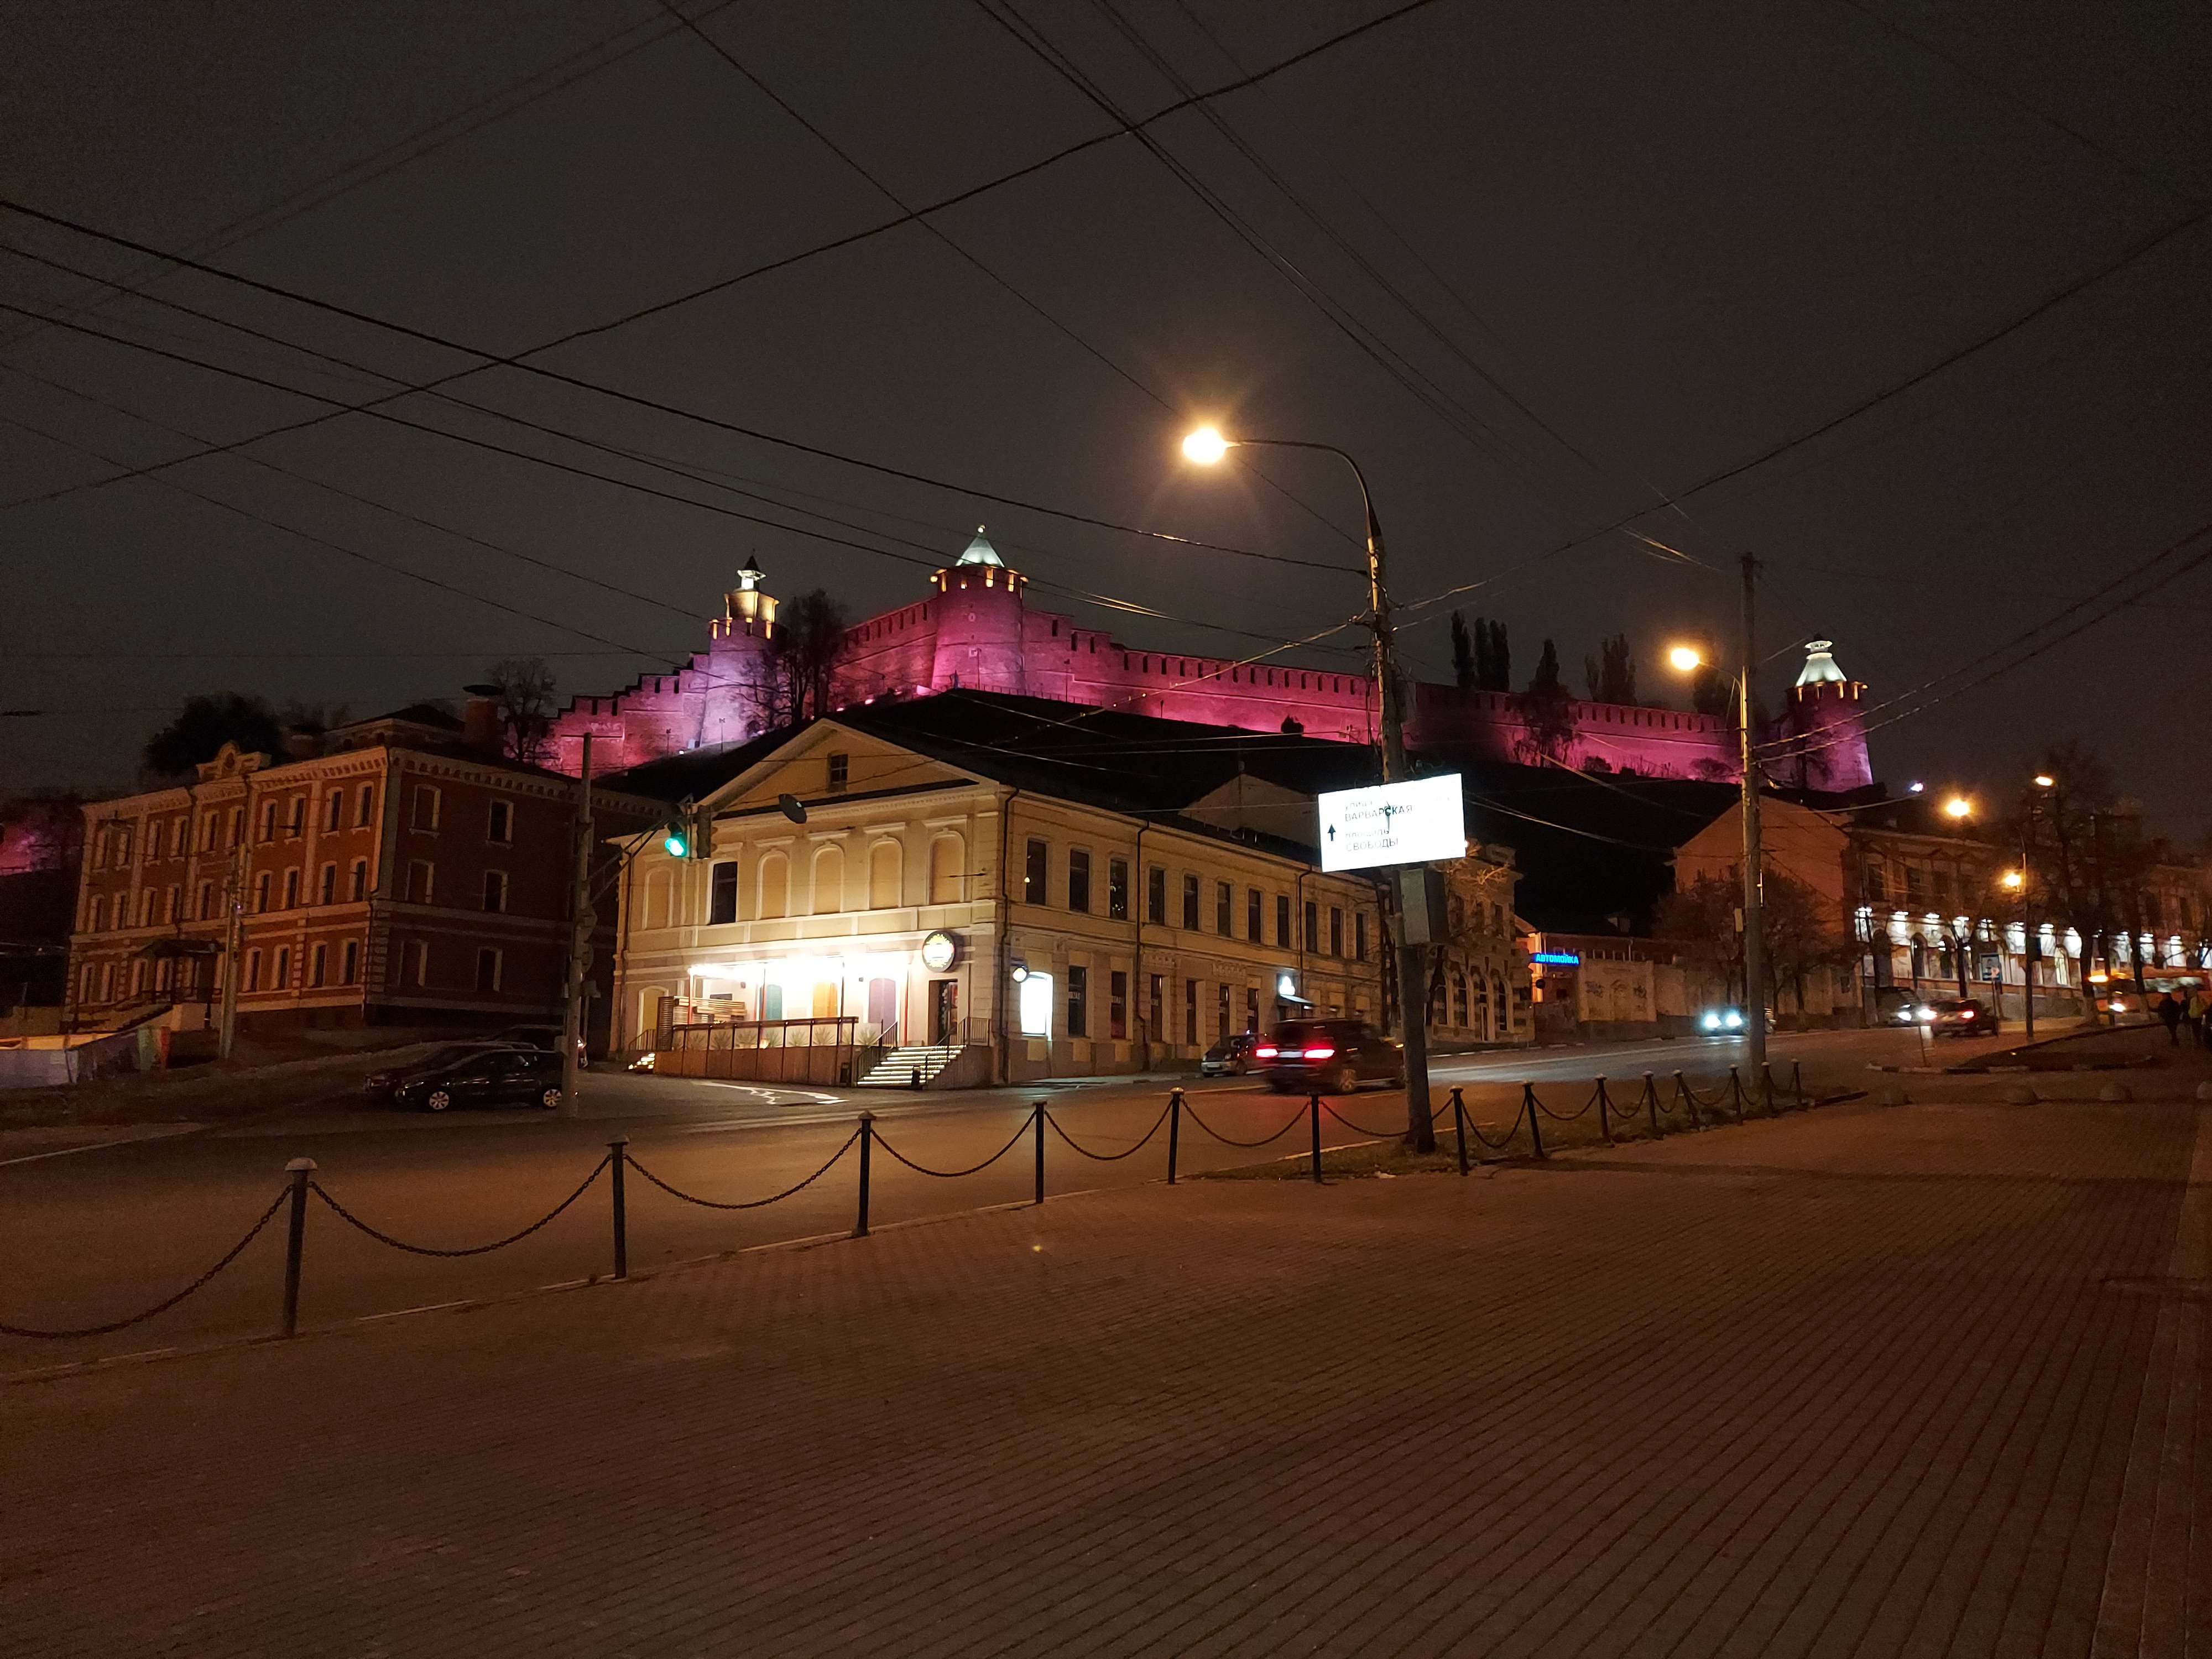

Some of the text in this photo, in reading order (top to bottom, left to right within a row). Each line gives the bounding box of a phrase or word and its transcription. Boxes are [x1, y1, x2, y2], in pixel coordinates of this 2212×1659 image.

[1344, 805, 1413, 822] ВАРВАРСКАЯ
[1345, 837, 1399, 852] СВОБОДЫ
[1536, 953, 1579, 965] АВТОМОЙКА
